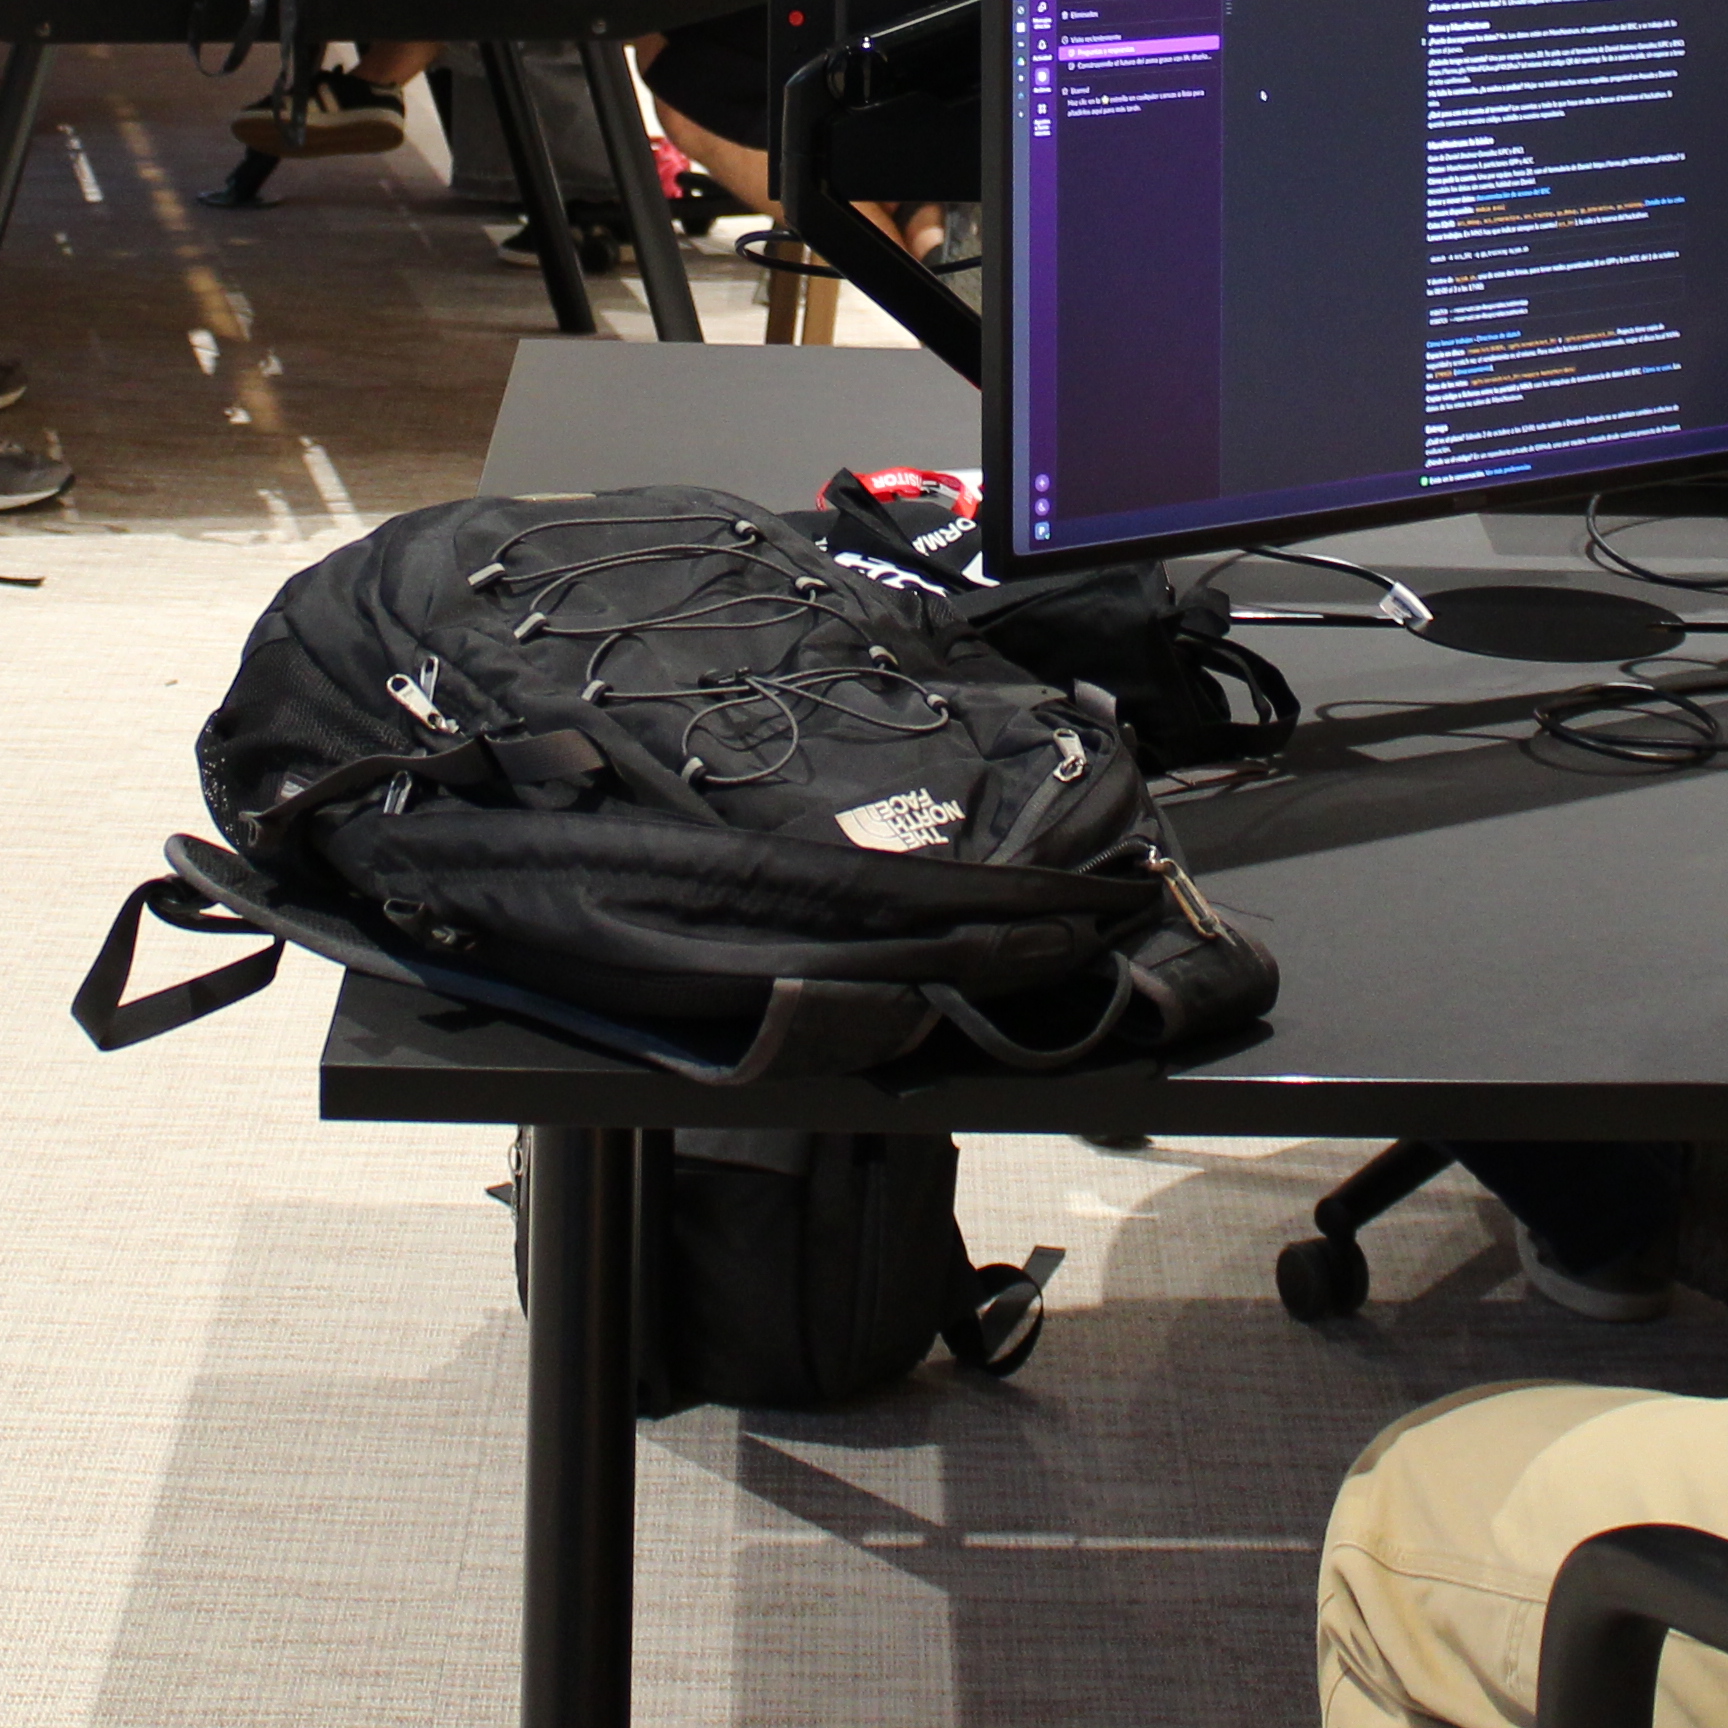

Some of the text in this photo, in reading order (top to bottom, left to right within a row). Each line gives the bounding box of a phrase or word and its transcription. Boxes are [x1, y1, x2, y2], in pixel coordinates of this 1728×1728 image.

[875, 787, 936, 820] FACE
[887, 799, 966, 834] NORTH
[899, 827, 950, 849] THE
